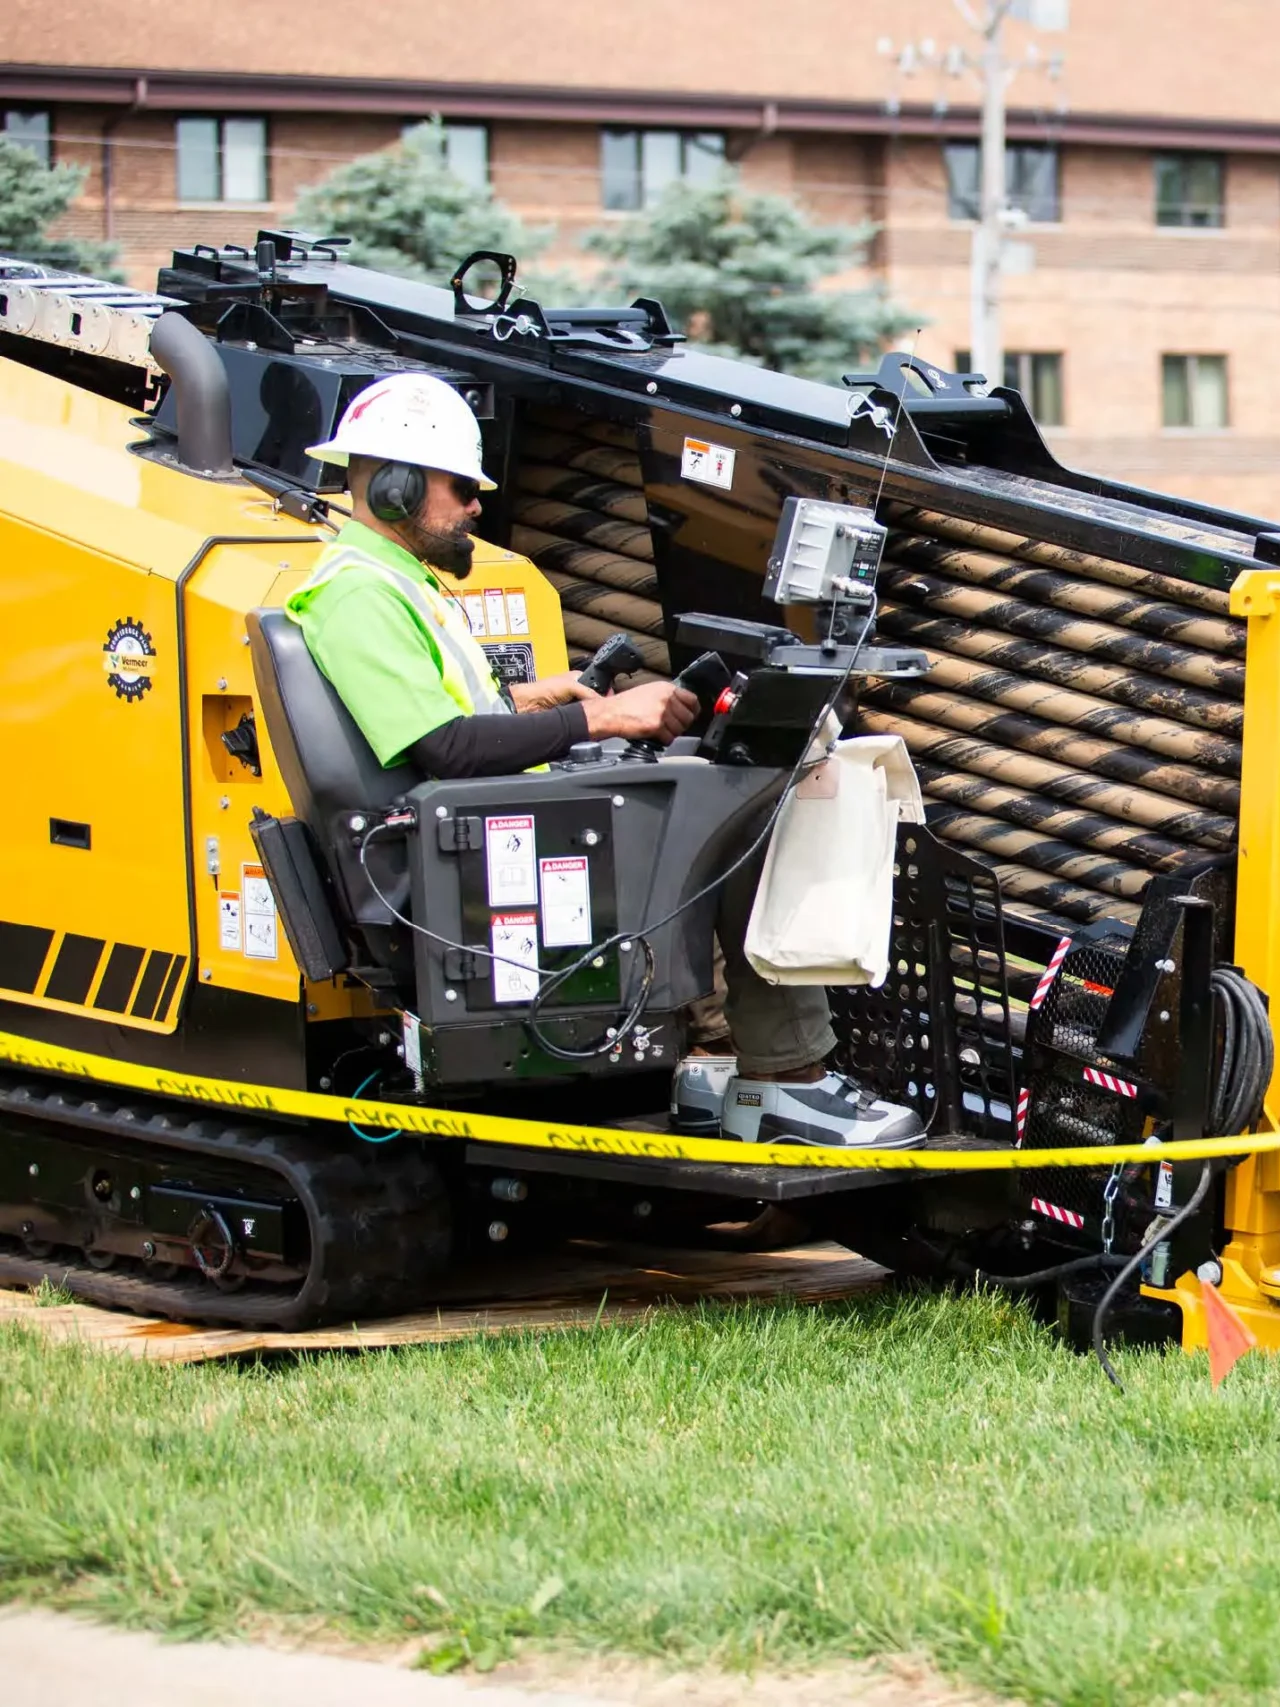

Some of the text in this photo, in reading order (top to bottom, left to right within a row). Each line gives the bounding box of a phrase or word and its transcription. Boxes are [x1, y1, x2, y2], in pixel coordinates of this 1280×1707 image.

[121, 655, 148, 668] Vermeer
[498, 819, 530, 828] DANGER
[551, 861, 583, 870] DANGER
[503, 915, 535, 925] DANGER
